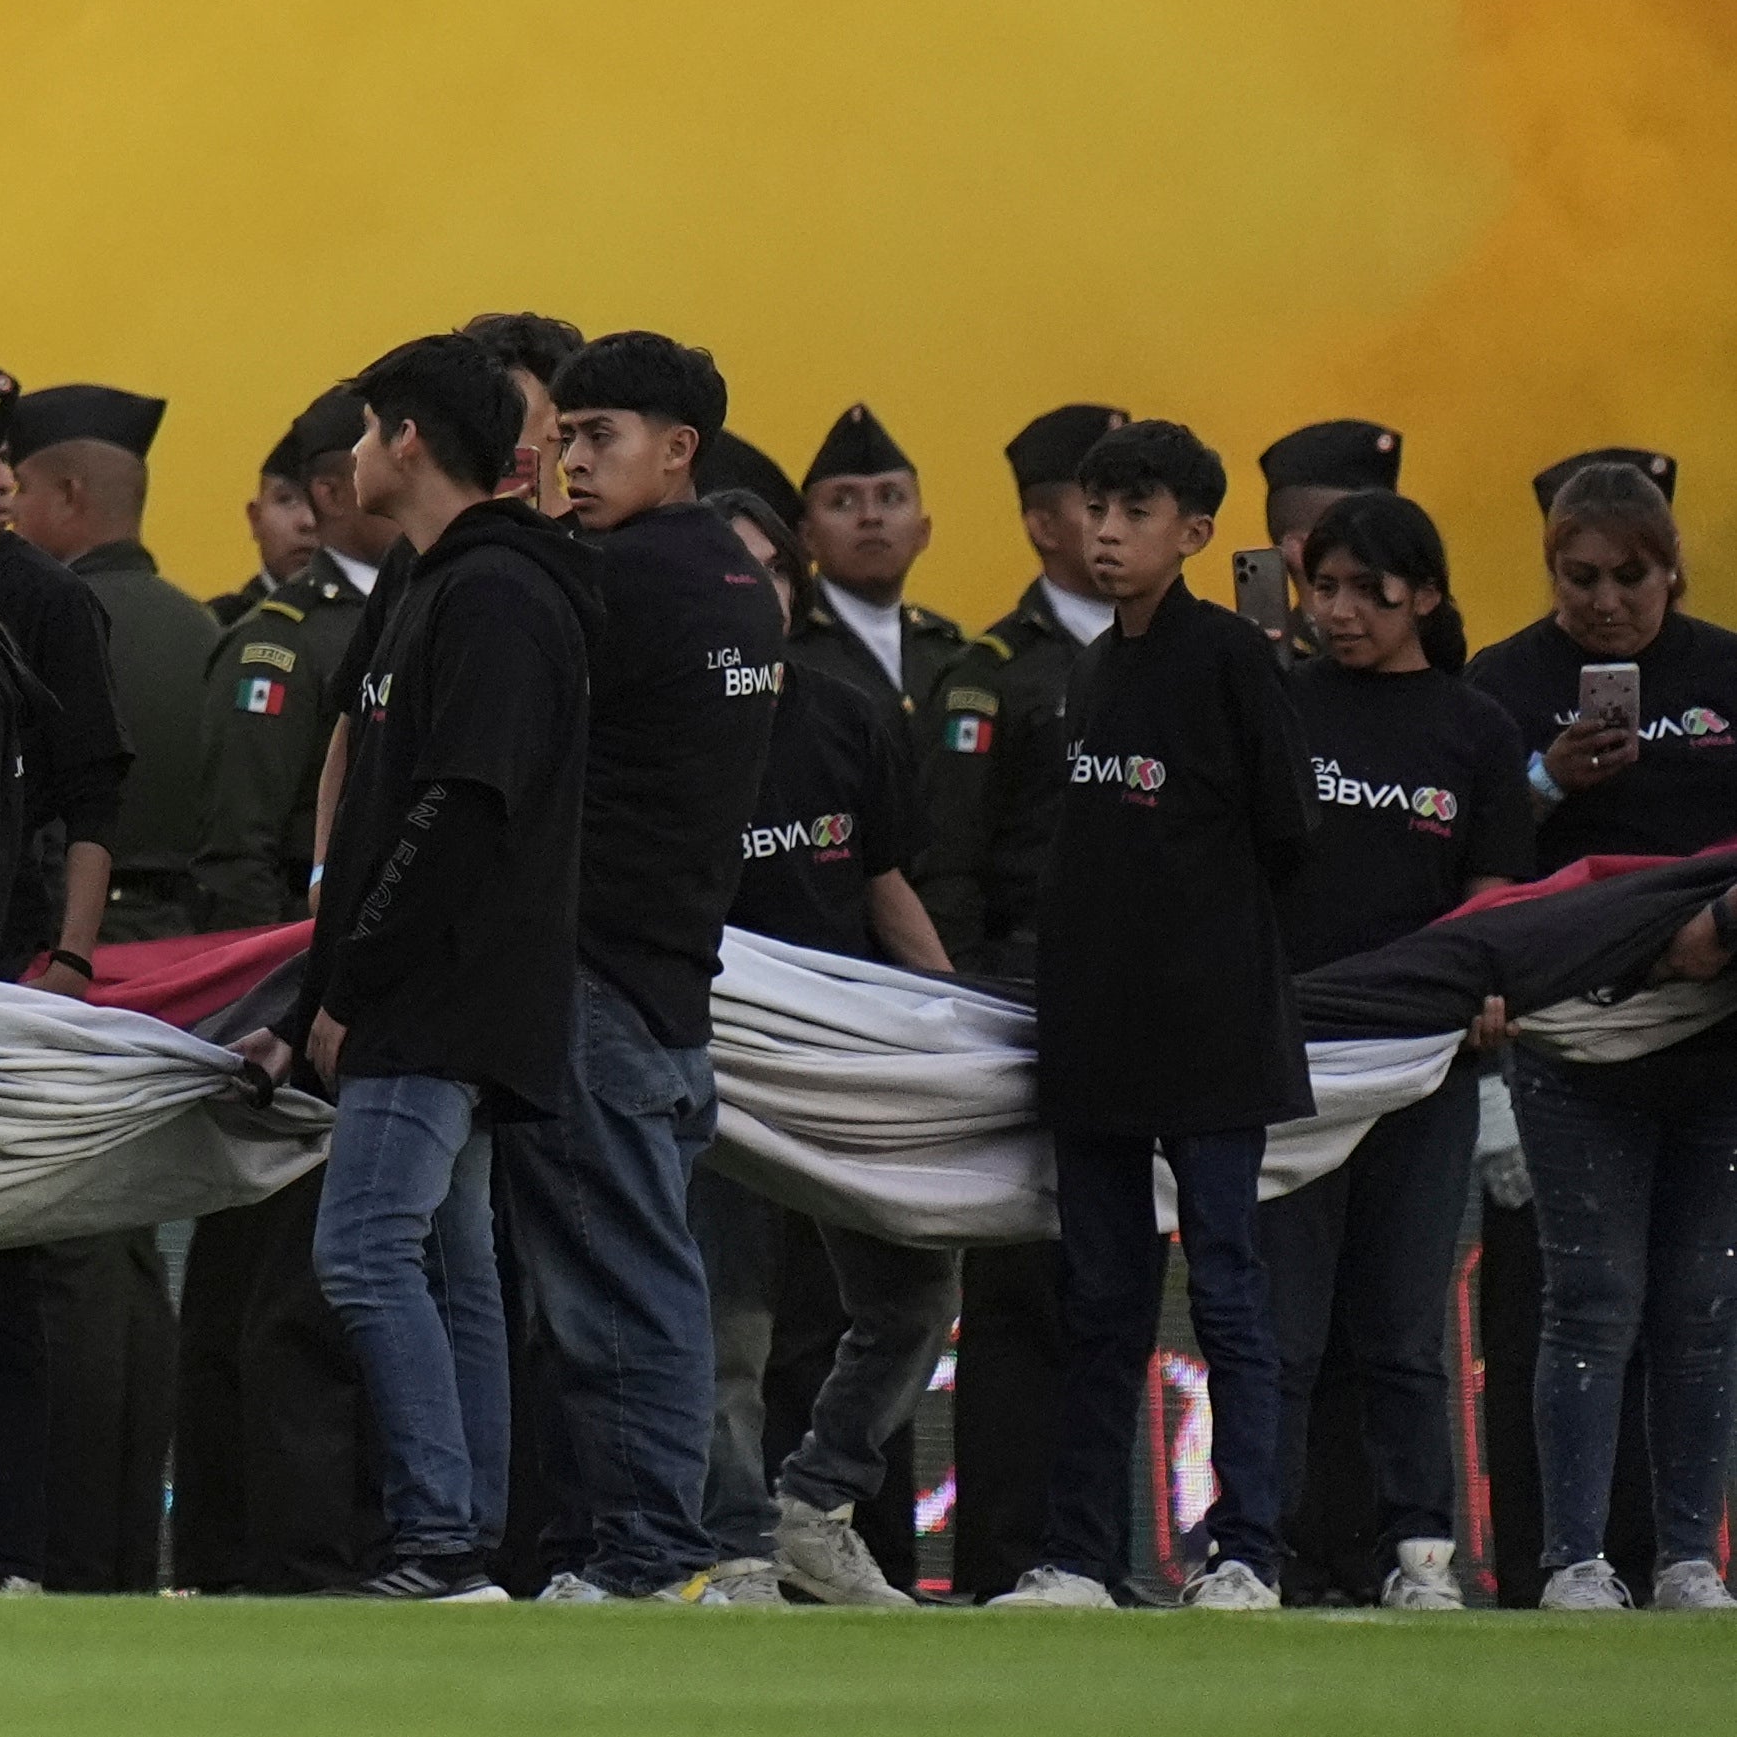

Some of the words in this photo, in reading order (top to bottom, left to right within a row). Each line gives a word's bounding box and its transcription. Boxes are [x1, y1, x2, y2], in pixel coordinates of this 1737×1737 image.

[706, 647, 743, 670] LIGA
[725, 664, 773, 697] BBVA
[1636, 715, 1684, 741] VA
[1071, 754, 1124, 784] BVA
[1310, 757, 1342, 777] GA
[1316, 774, 1410, 811] BBVA
